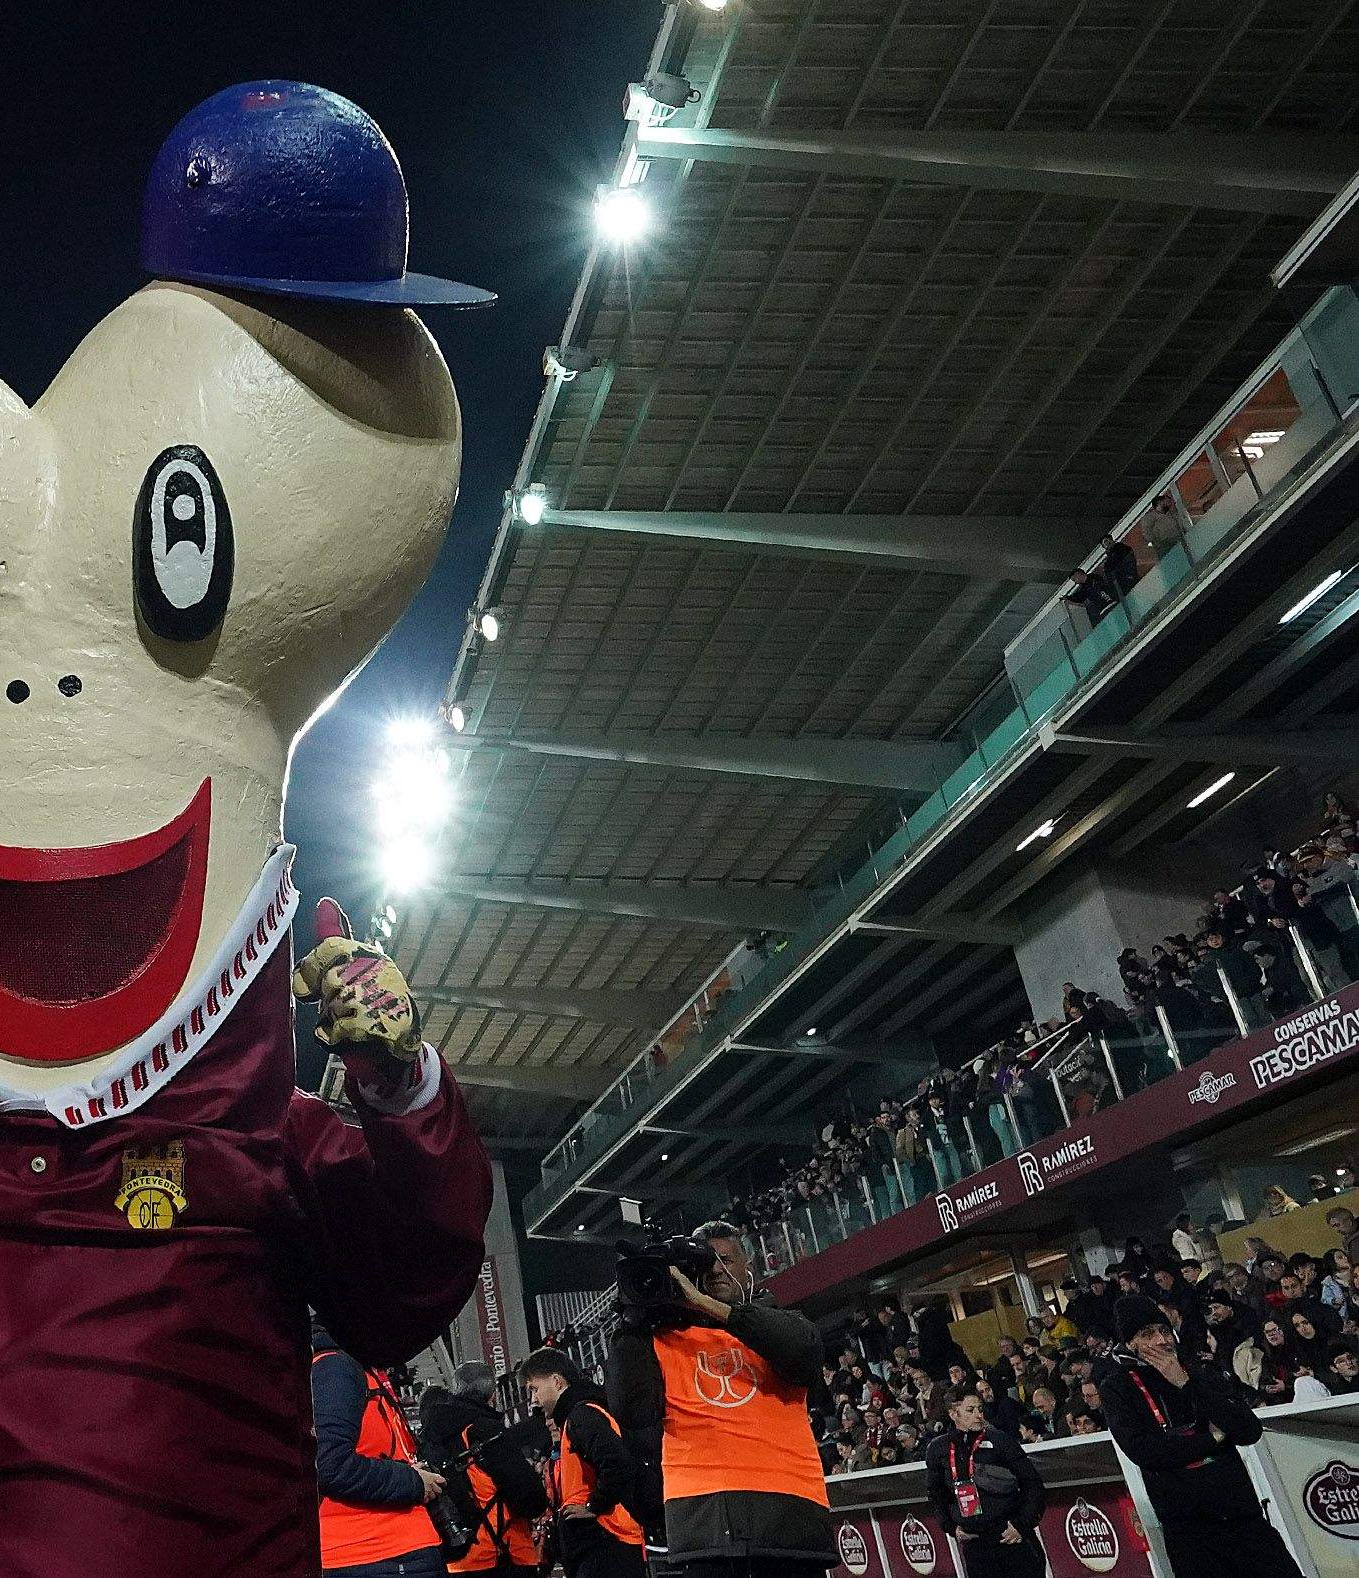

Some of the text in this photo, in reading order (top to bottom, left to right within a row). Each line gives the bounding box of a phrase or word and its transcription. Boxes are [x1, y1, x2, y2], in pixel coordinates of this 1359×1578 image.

[1273, 1000, 1341, 1043] CONSERVAS
[1249, 1009, 1359, 1089] PESCAMA
[1188, 1072, 1237, 1104] PESCAMAR
[1042, 1135, 1095, 1172] RAMÍREZ
[121, 1177, 183, 1196] PONTEVEDRA
[956, 1181, 999, 1213] RAMÍREZ
[479, 1261, 500, 1331] Pontevedra
[1317, 1485, 1359, 1505] Estre
[1071, 1518, 1109, 1537] Estrella
[1325, 1503, 1359, 1522] Gali
[1077, 1536, 1113, 1556] Galicia
